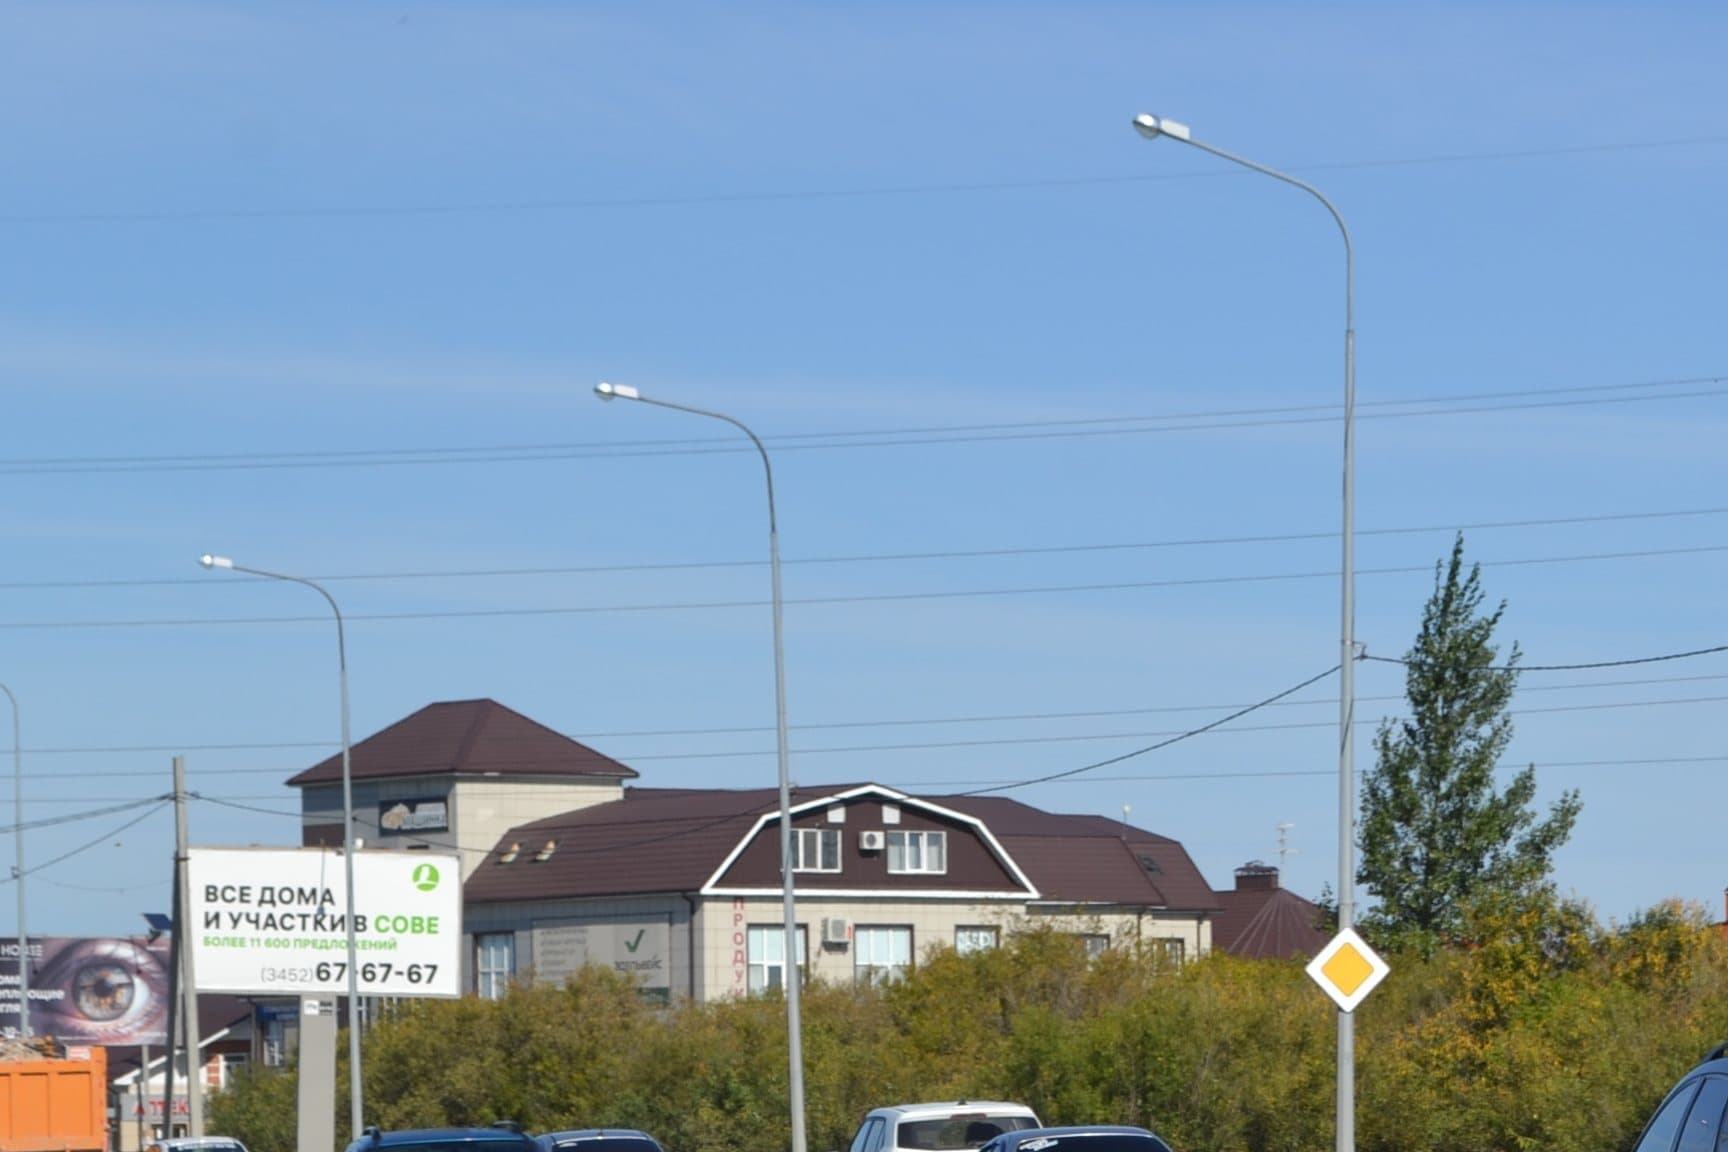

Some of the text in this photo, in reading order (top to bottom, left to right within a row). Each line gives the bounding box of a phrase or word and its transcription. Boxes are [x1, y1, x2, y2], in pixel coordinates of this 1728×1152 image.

[204, 885, 336, 907] ВСЕ ДОМА
[204, 912, 440, 935] И УЧАСТКИ В СОВЕ
[203, 936, 246, 948] БОЛЕЕ
[250, 938, 261, 948] 11
[265, 938, 290, 949] 600
[260, 967, 314, 983] (3452)
